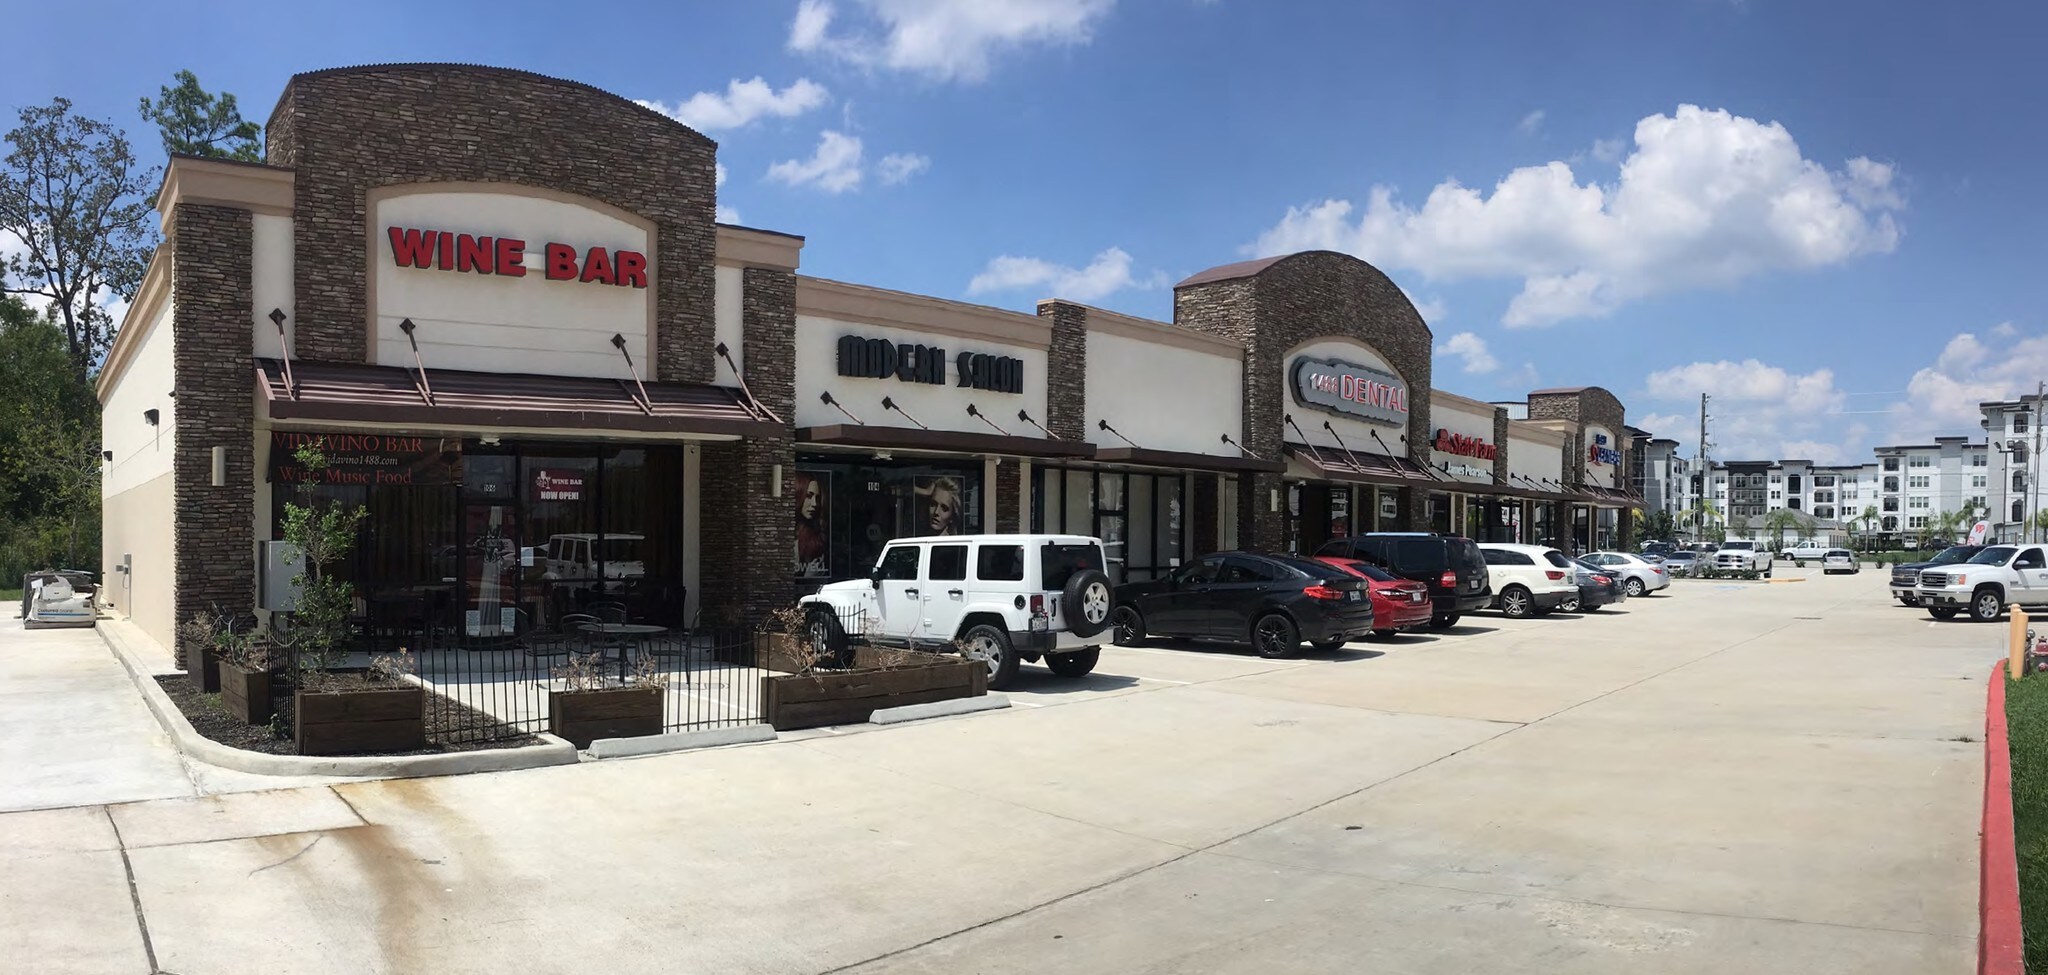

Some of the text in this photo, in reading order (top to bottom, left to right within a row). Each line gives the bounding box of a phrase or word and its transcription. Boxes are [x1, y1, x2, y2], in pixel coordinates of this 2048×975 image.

[388, 226, 648, 289] WINE BAR
[837, 334, 1023, 395] MODERN SALON
[1310, 372, 1408, 413] 1488 DENTAL
[273, 432, 424, 453] VIDAVINO BAR
[1450, 432, 1497, 460] State Farm
[279, 466, 412, 484] Wine Music Food
[1446, 461, 1488, 479] James Pearson
[540, 491, 579, 500] NOW OPEN!
